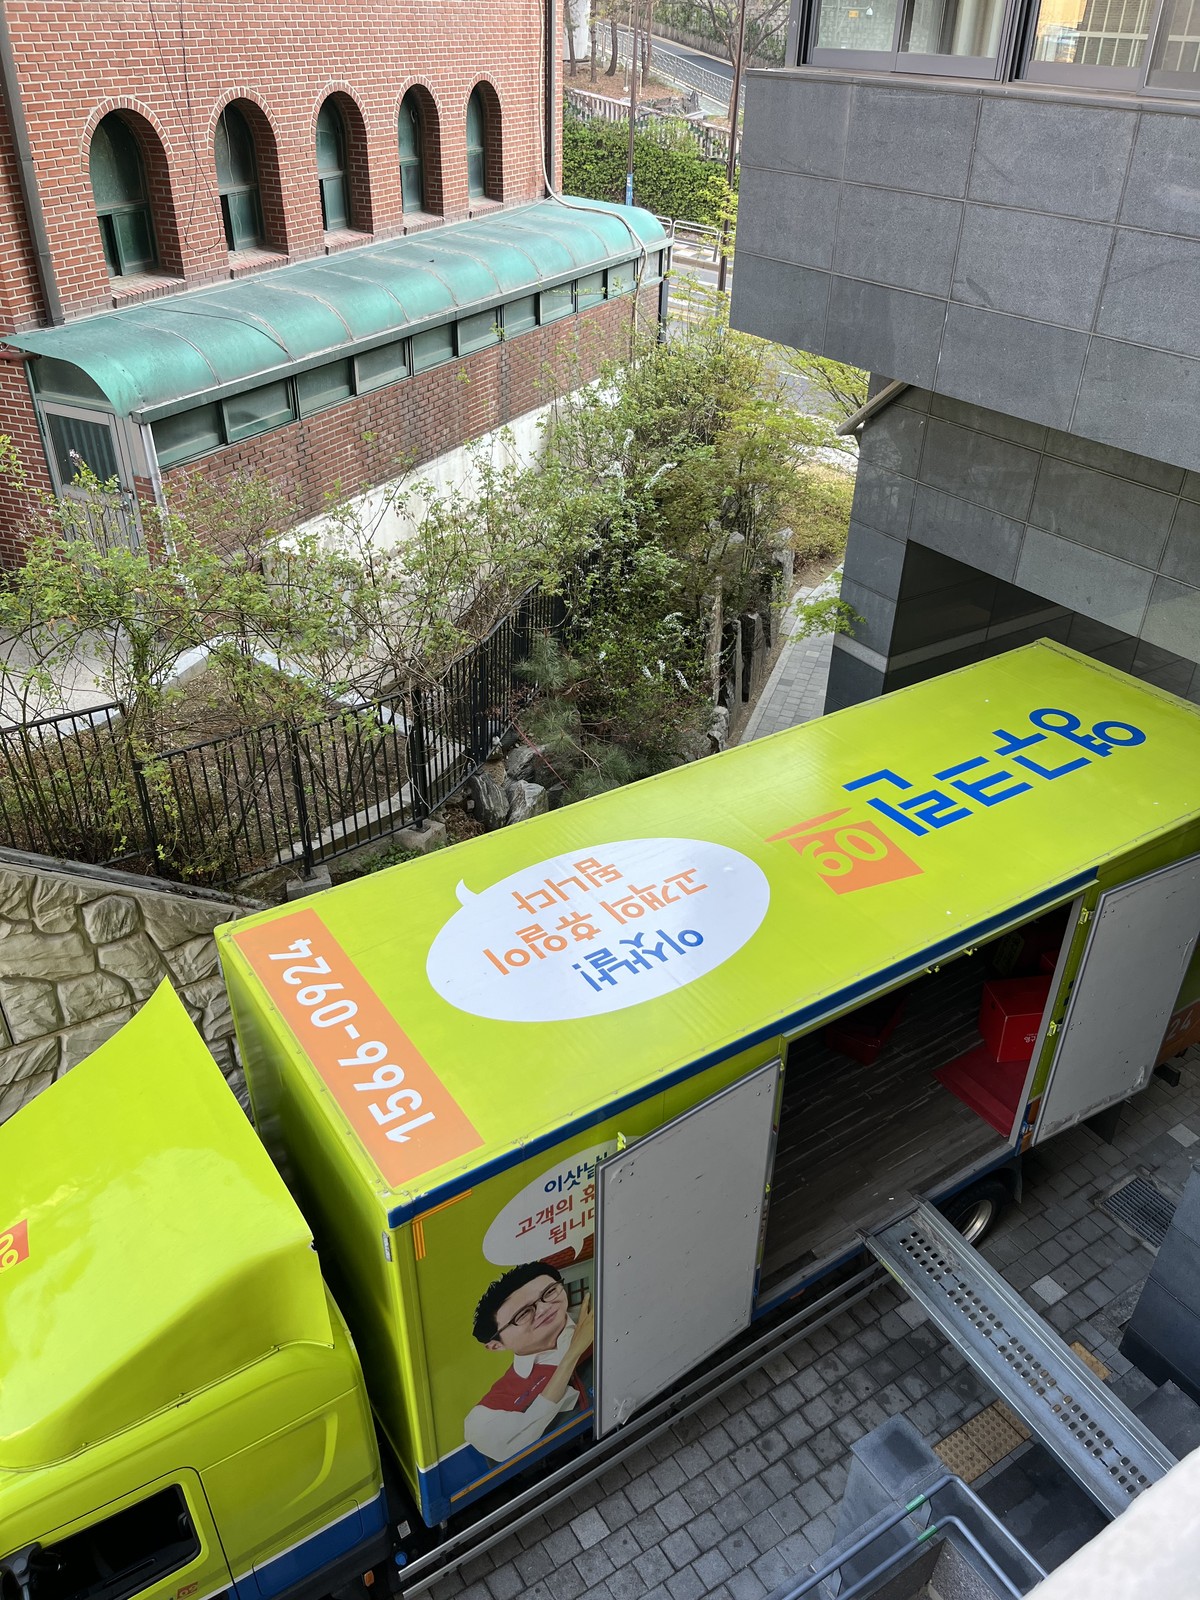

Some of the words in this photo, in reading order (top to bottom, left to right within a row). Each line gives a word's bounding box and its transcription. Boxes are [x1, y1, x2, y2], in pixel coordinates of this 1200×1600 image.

[842, 708, 1146, 837] 영구크린
[800, 828, 888, 877] 09
[511, 857, 623, 914] 됩니다
[599, 868, 709, 925] 고객의
[482, 911, 602, 976] 휴일이
[572, 929, 704, 992] 이삿날!
[268, 938, 436, 1143] 1566-0924
[515, 1194, 573, 1238] 고객의
